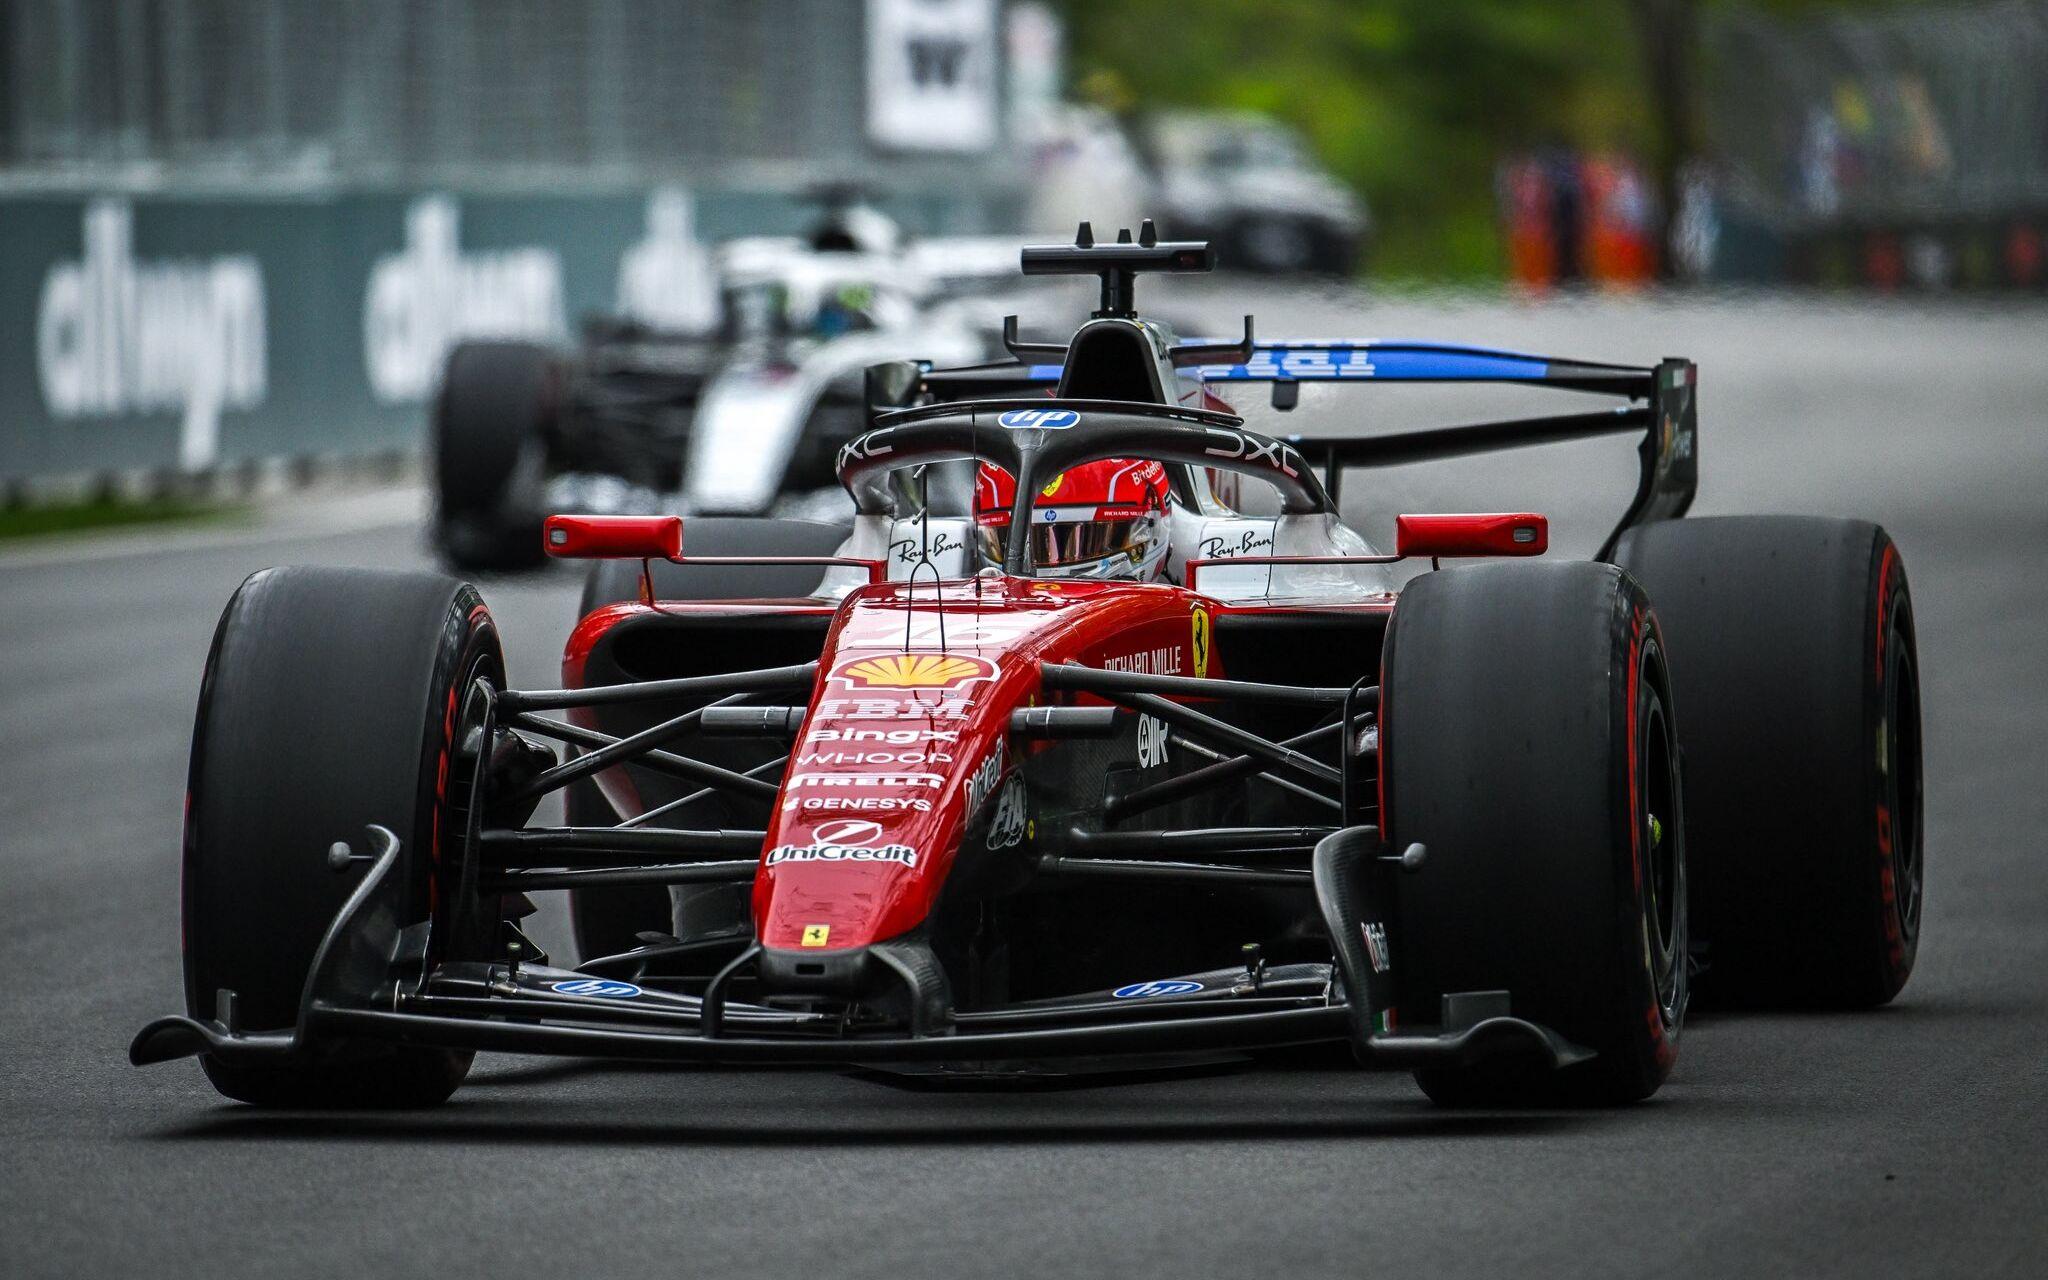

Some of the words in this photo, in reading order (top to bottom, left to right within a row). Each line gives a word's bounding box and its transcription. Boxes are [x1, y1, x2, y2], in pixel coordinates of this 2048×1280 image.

[1205, 428, 1300, 478] DXC
[888, 533, 963, 562] Ra-Ban
[1199, 530, 1271, 559] Ray-Ban
[1152, 645, 1181, 675] MILLE
[812, 699, 975, 722] IBM
[797, 753, 953, 766] WHOOP
[786, 772, 946, 791] PIRELLI
[803, 798, 932, 812] GENESYS
[767, 844, 916, 866] UniCredit
